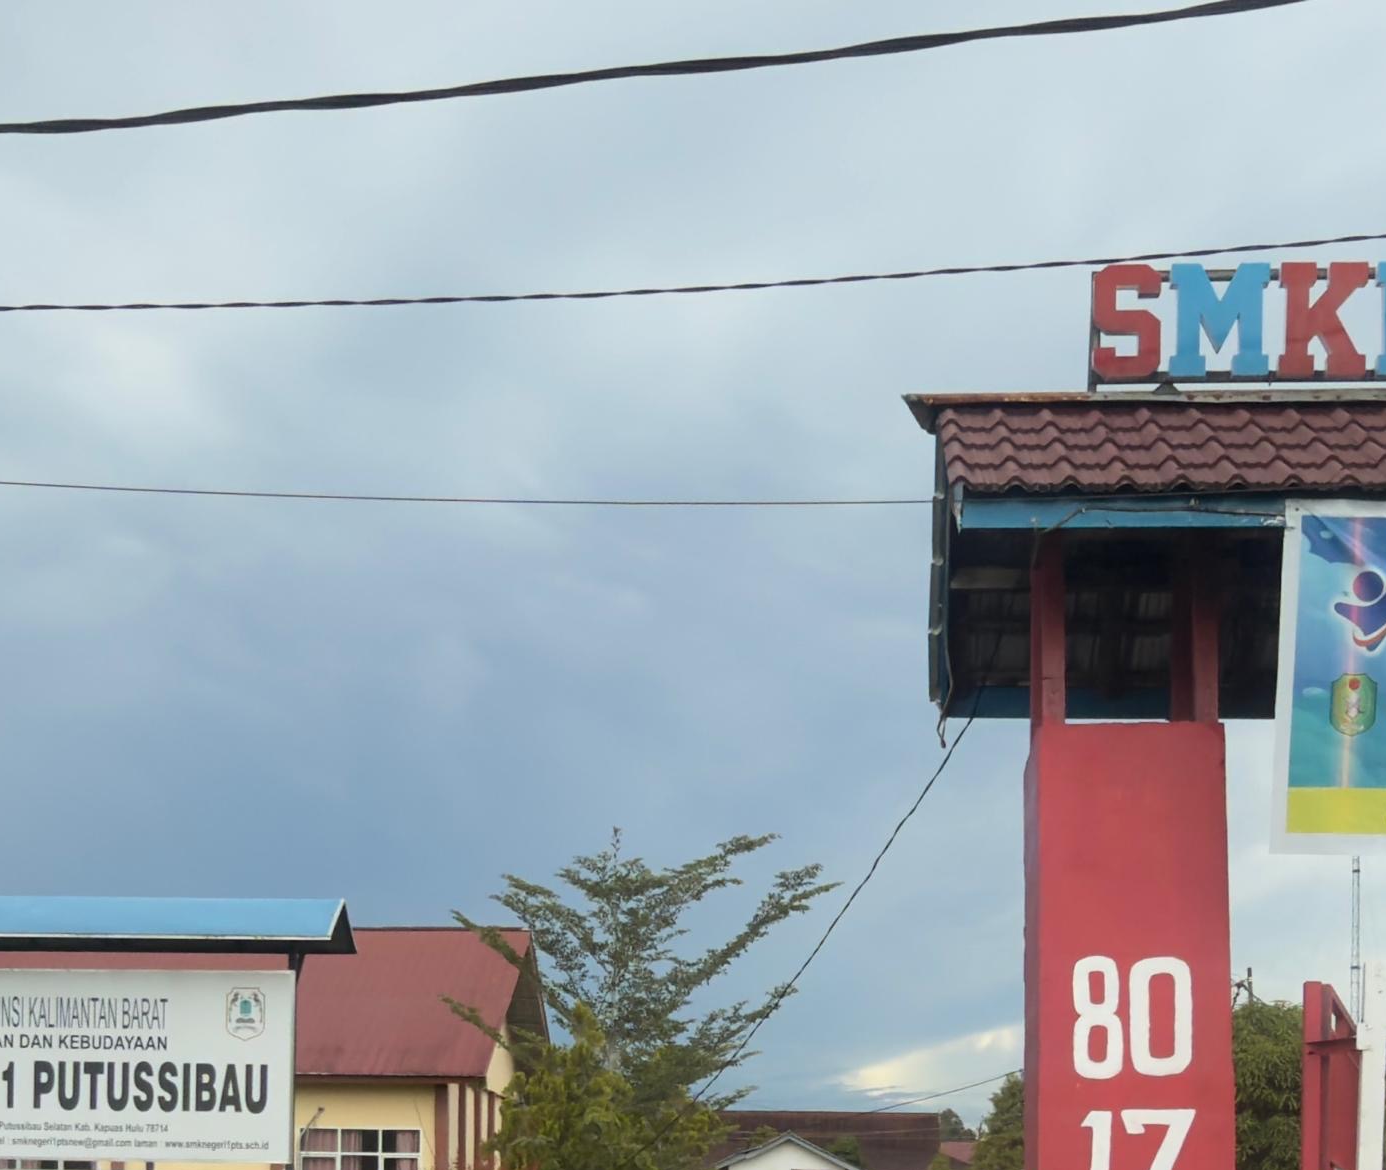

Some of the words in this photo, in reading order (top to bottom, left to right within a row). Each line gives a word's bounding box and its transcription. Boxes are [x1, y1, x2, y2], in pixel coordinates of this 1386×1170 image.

[28, 997, 118, 1030] KALIMANTAN
[122, 998, 169, 1031] BARAT
[1073, 955, 1193, 1081] 80
[19, 1033, 53, 1049] DAN
[58, 1034, 168, 1051] KEBUDAYAAN
[2, 1061, 14, 1109] 1
[33, 1061, 269, 1114] PUTUSSIBAU
[44, 1121, 73, 1131] Selatan
[94, 1123, 124, 1133] Kapuas
